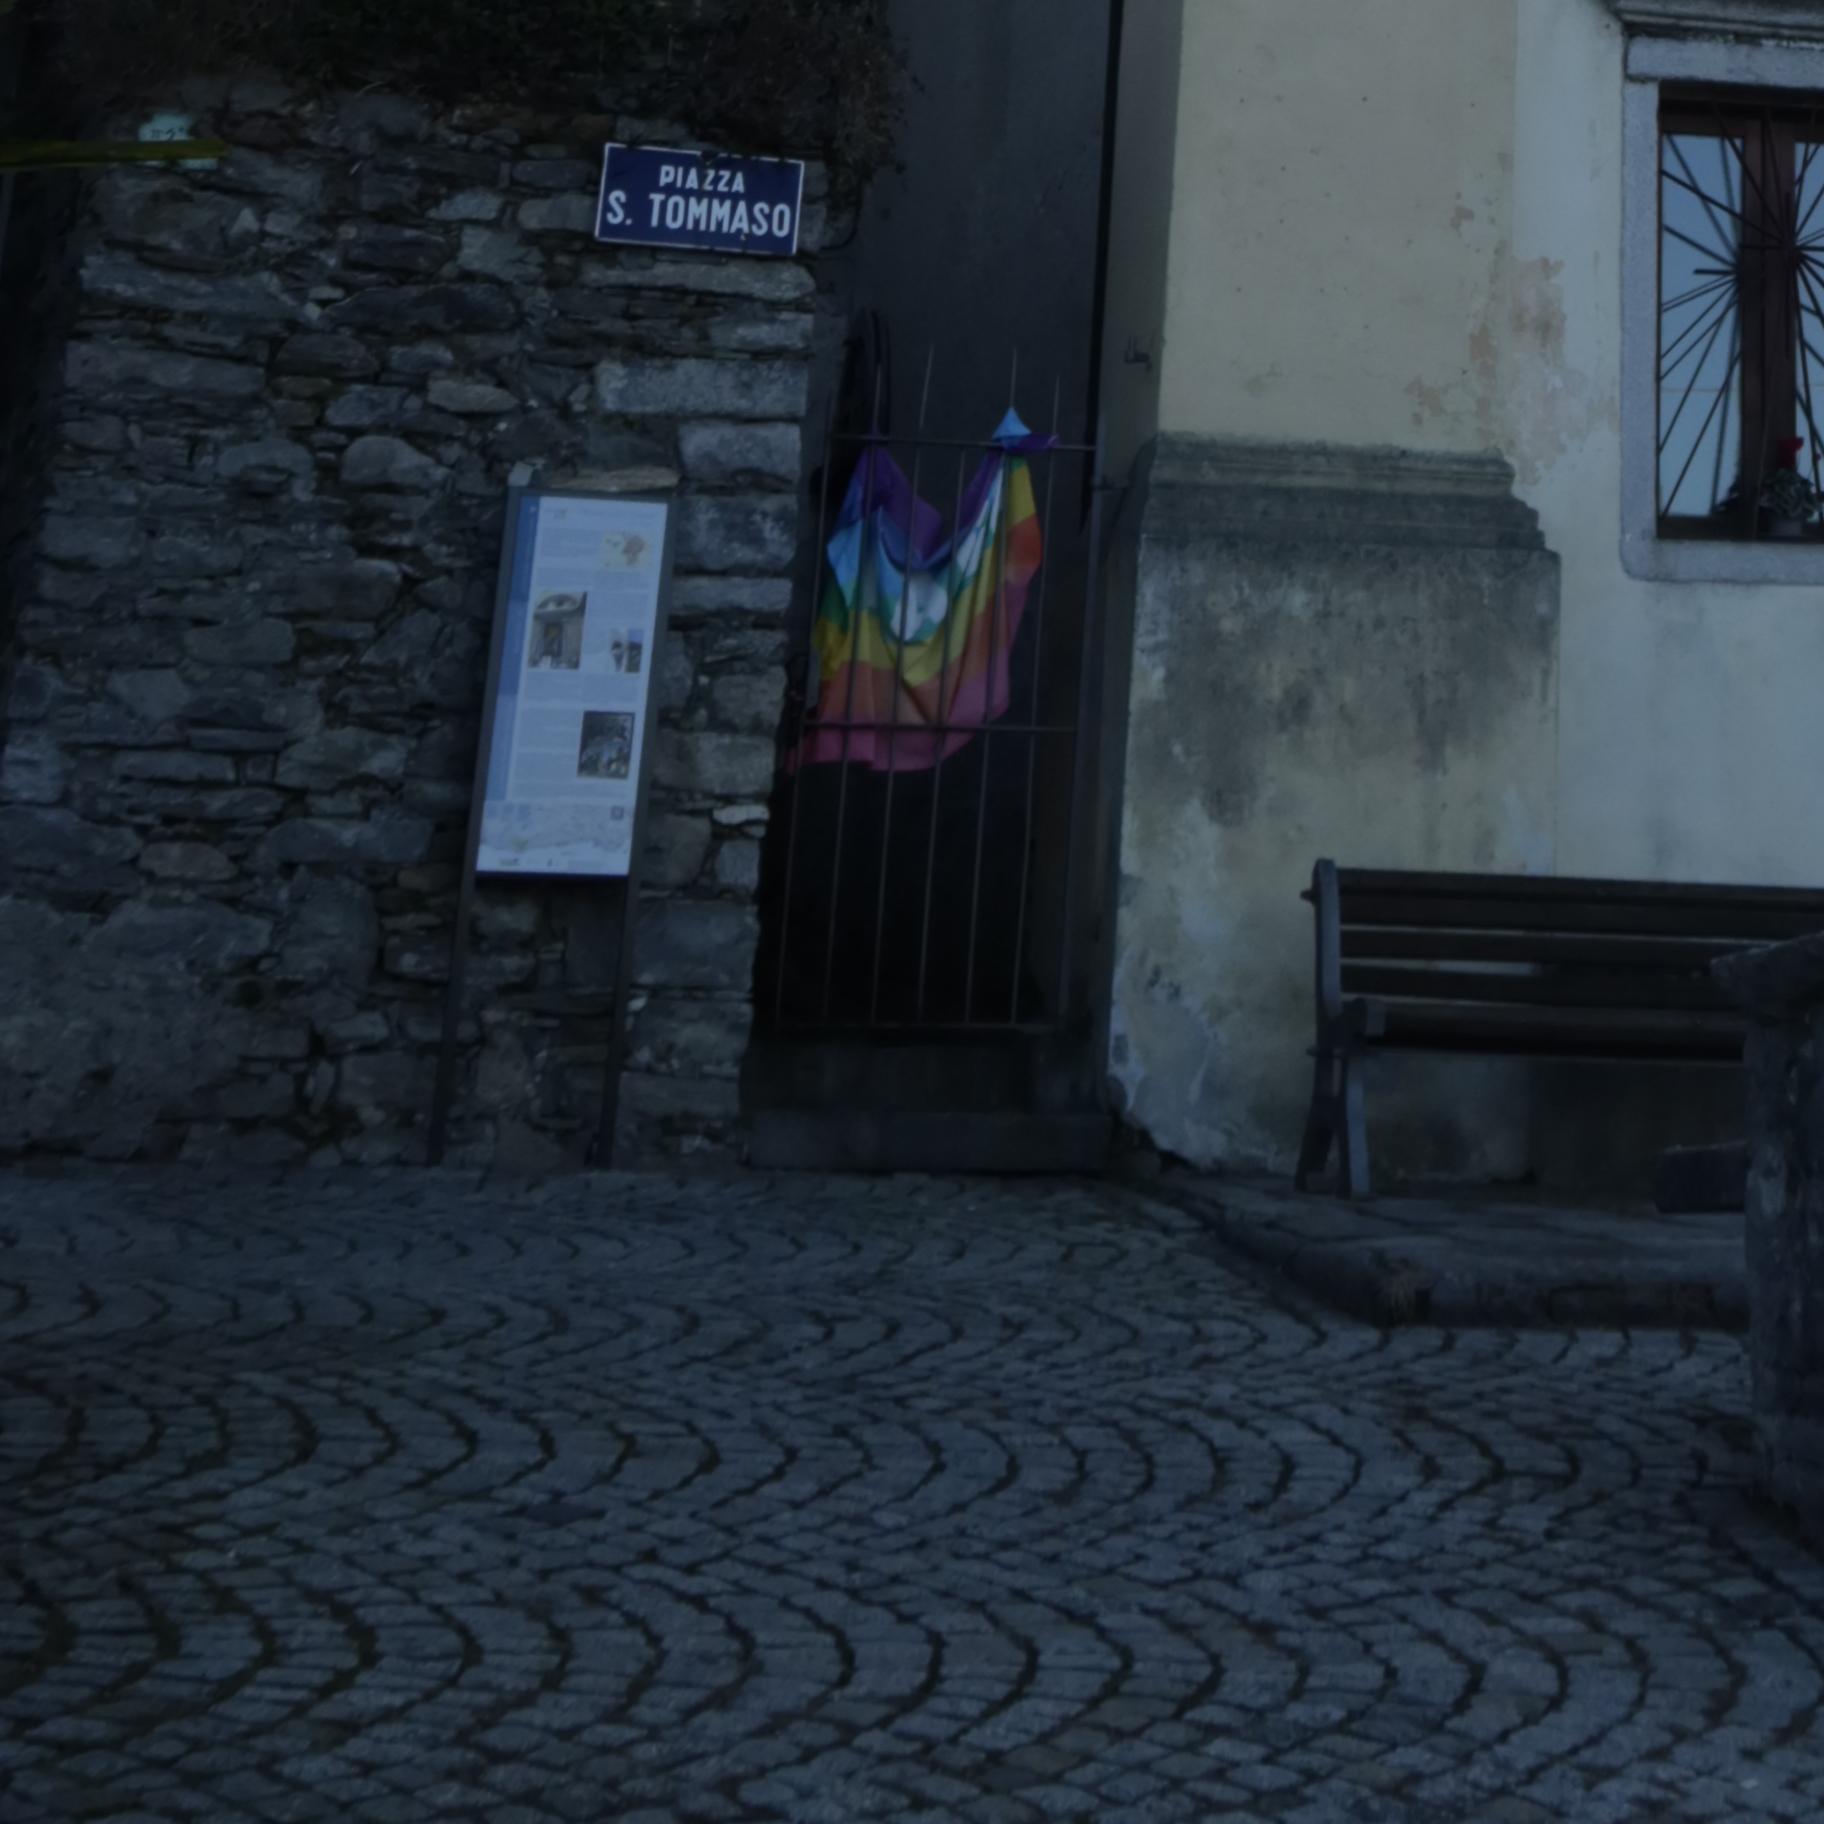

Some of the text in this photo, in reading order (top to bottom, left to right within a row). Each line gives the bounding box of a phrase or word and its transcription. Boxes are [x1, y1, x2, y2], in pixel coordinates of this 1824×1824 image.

[659, 165, 745, 193] PIAZZA
[606, 190, 791, 237] S. TOMMASO
